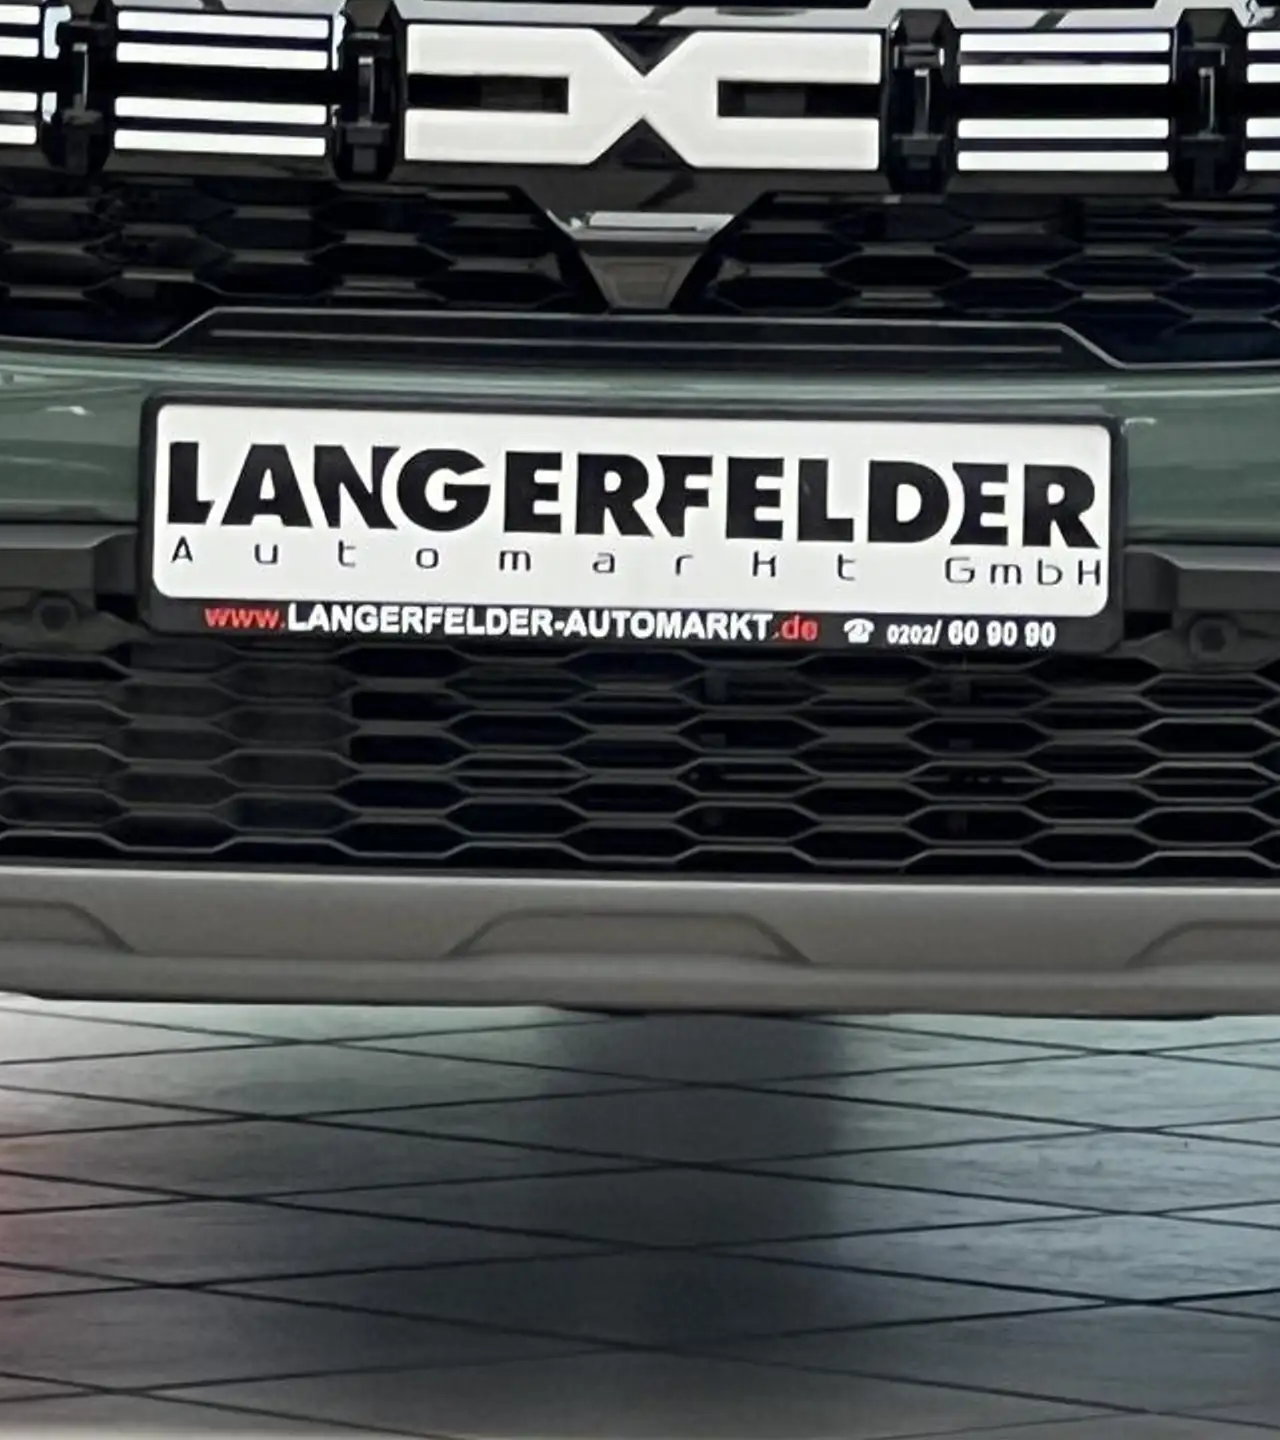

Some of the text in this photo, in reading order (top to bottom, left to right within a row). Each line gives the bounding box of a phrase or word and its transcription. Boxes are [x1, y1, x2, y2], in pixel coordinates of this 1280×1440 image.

[168, 441, 1100, 548] LANGERFELDER
[945, 556, 1102, 586] GmbH
[204, 603, 818, 641] www.LANGERFELDER-AUTOMARKT.de
